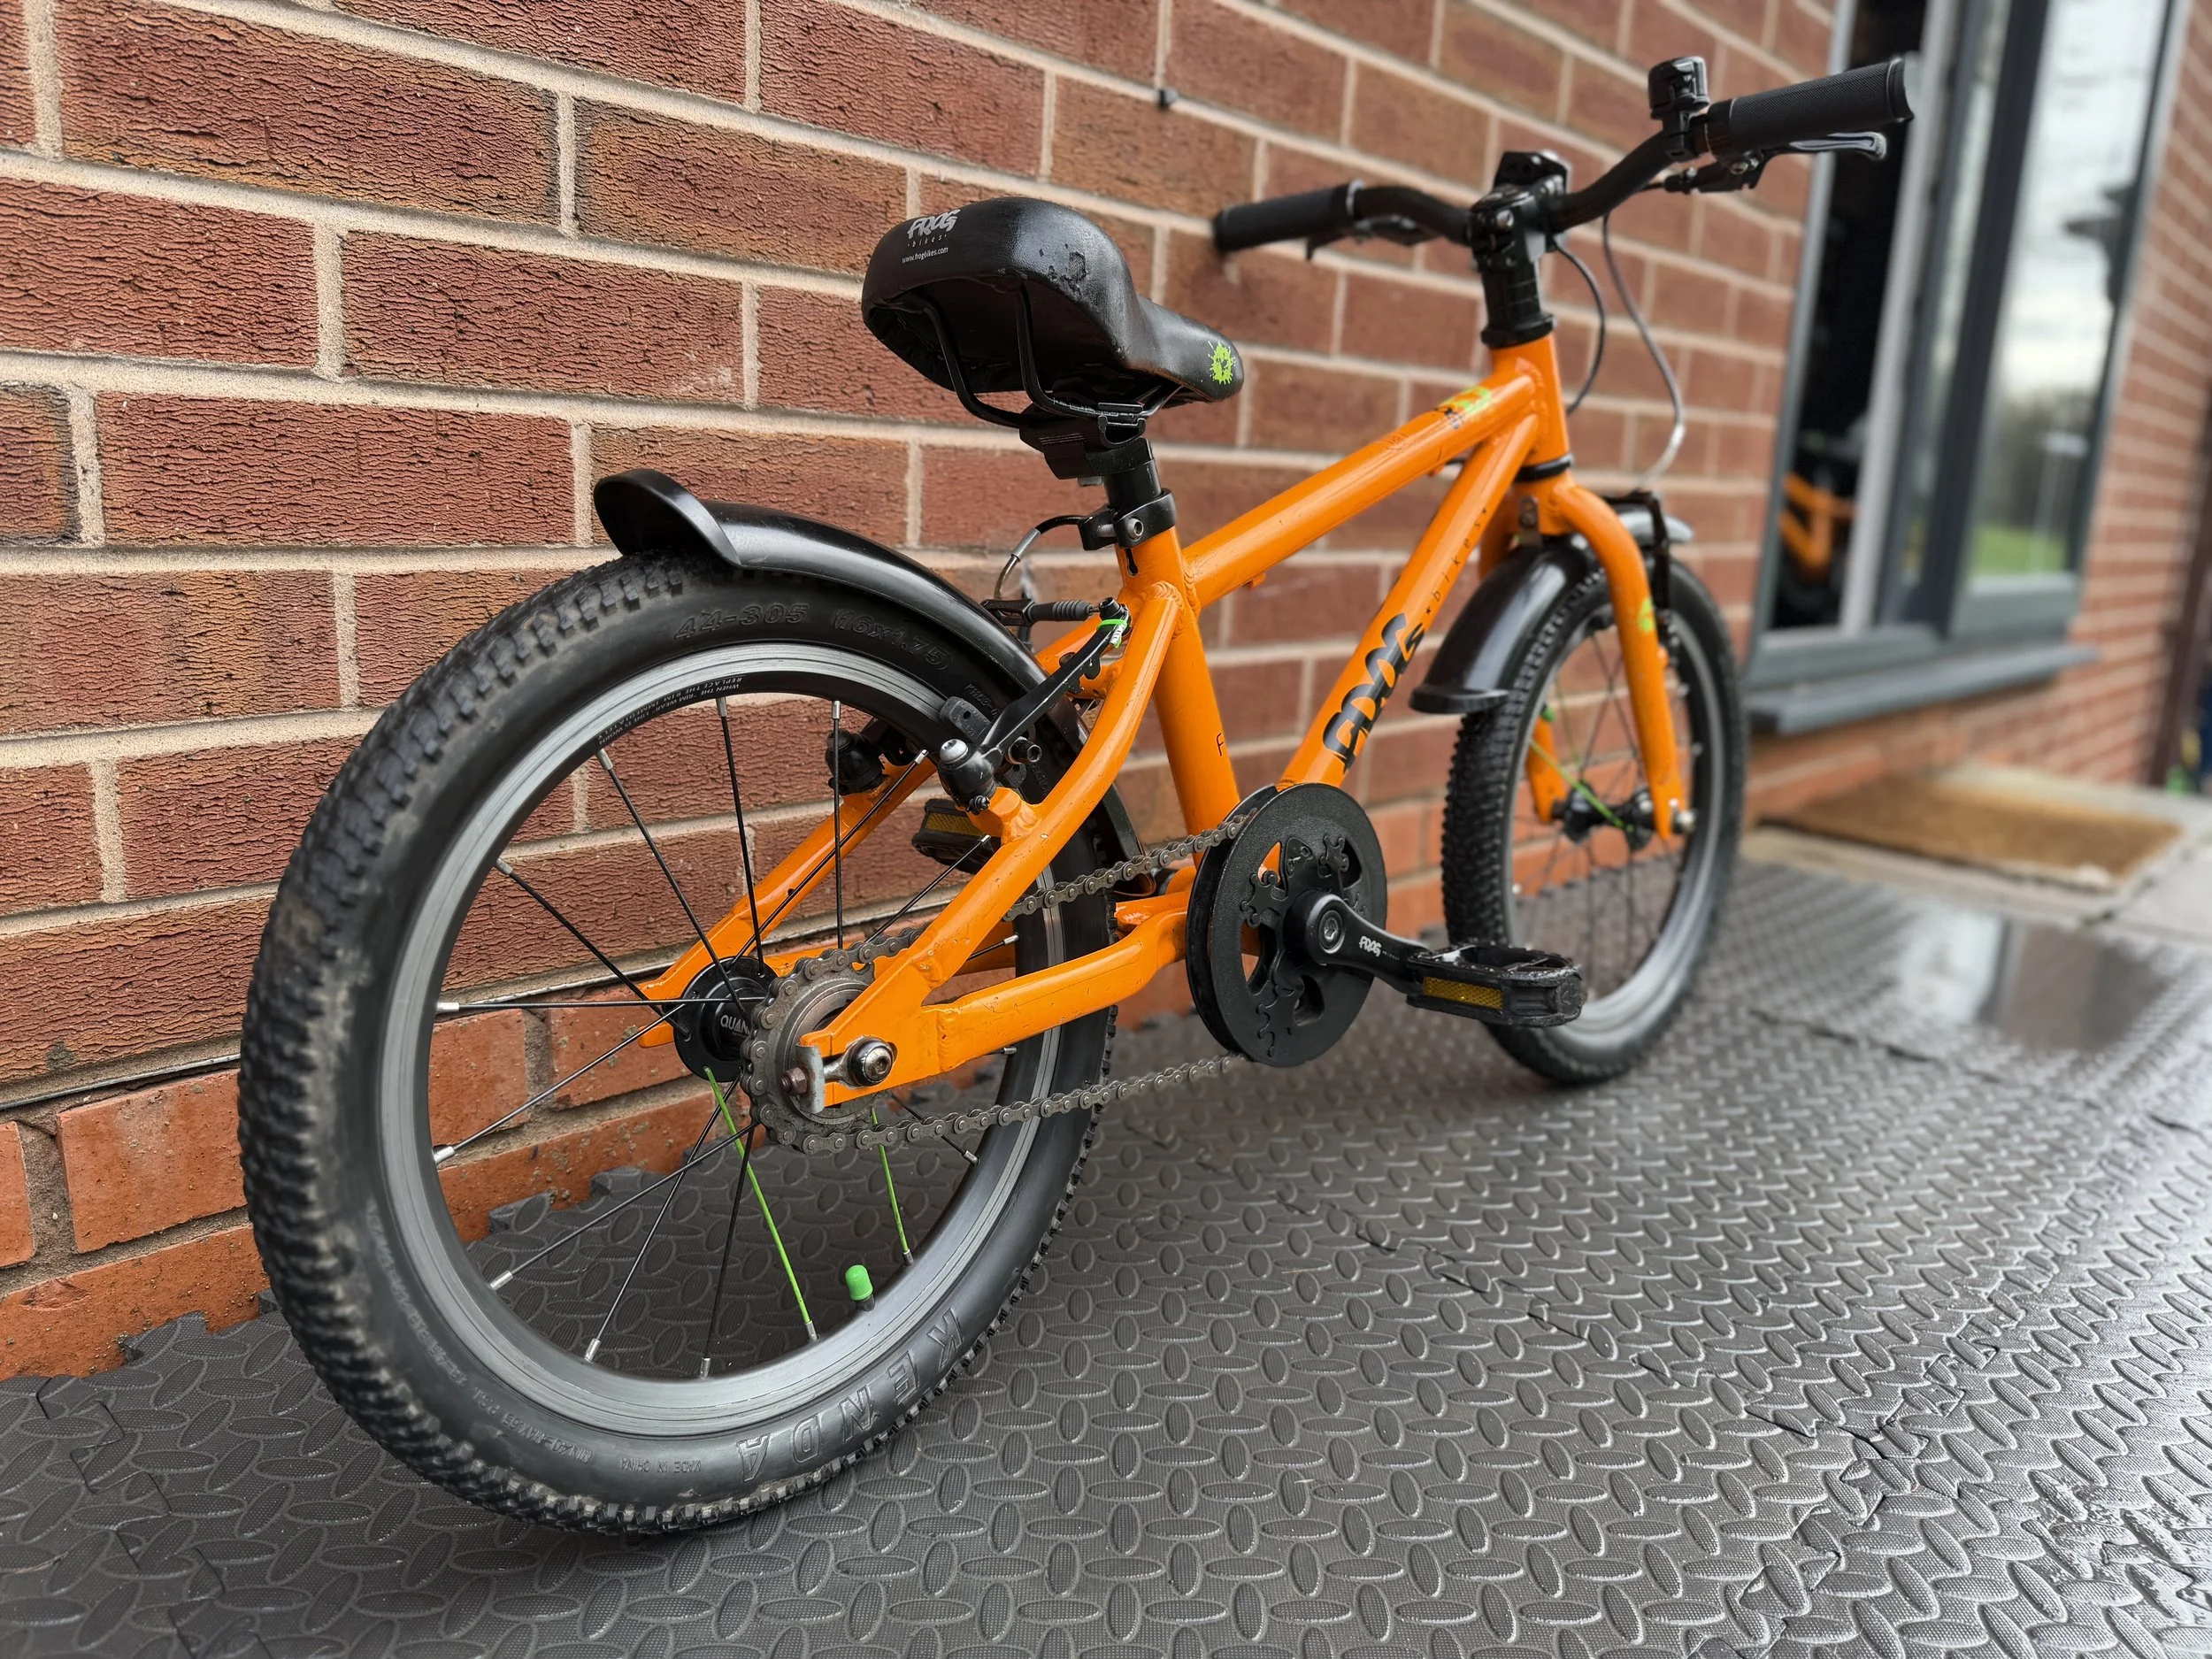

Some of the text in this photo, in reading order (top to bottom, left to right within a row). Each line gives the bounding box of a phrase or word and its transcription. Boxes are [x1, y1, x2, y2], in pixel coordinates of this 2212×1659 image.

[907, 209, 961, 240] FROG
[902, 247, 949, 263] www.frogbikes.com
[1358, 935, 1382, 957] FROG
[720, 1014, 751, 1036] QUAN
[736, 1307, 964, 1483] KENDA
[657, 1460, 668, 1473] IN
[673, 1459, 702, 1473] MADE
